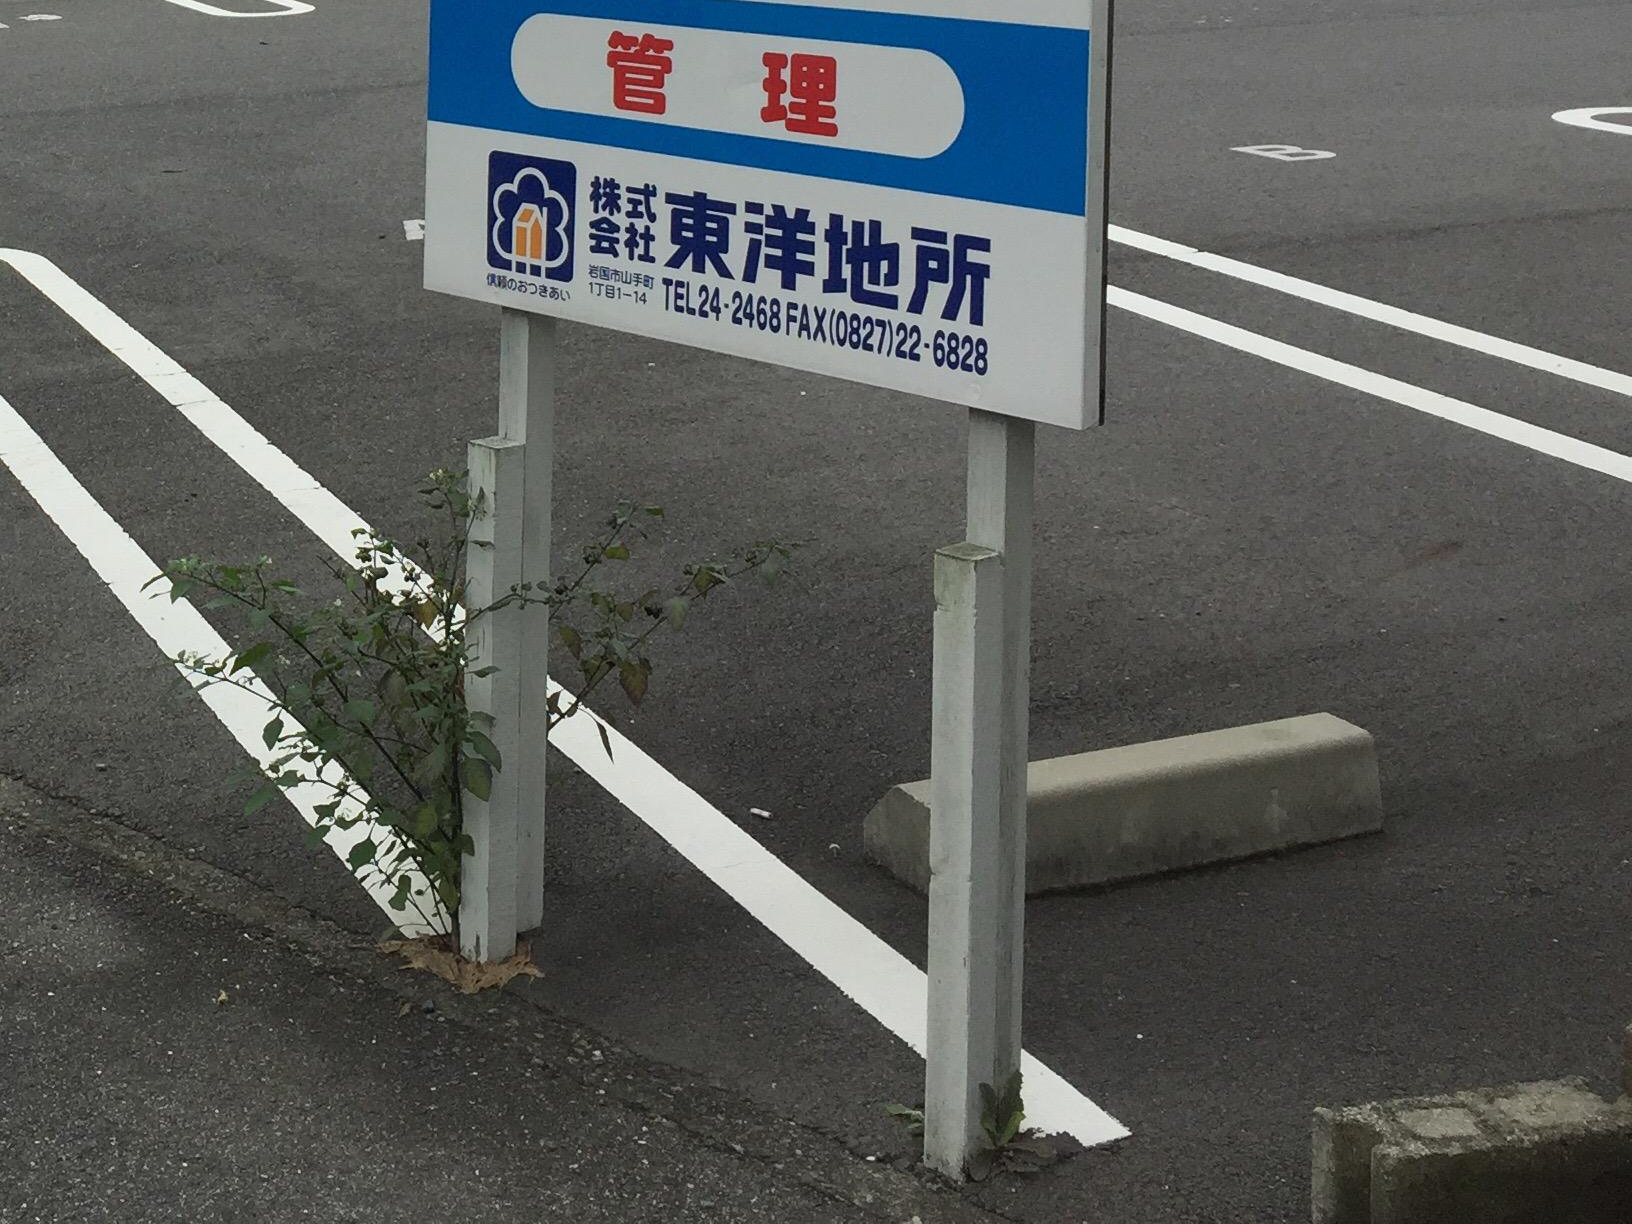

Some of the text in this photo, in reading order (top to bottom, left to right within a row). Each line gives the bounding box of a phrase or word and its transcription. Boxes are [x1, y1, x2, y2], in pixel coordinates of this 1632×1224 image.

[608, 31, 838, 137] 管理
[486, 273, 571, 301] 信頼のおつきあい
[588, 264, 655, 290] 岩国市山手町
[664, 191, 991, 328] 東洋地所
[786, 302, 989, 376] FAX(0827)22-6828
